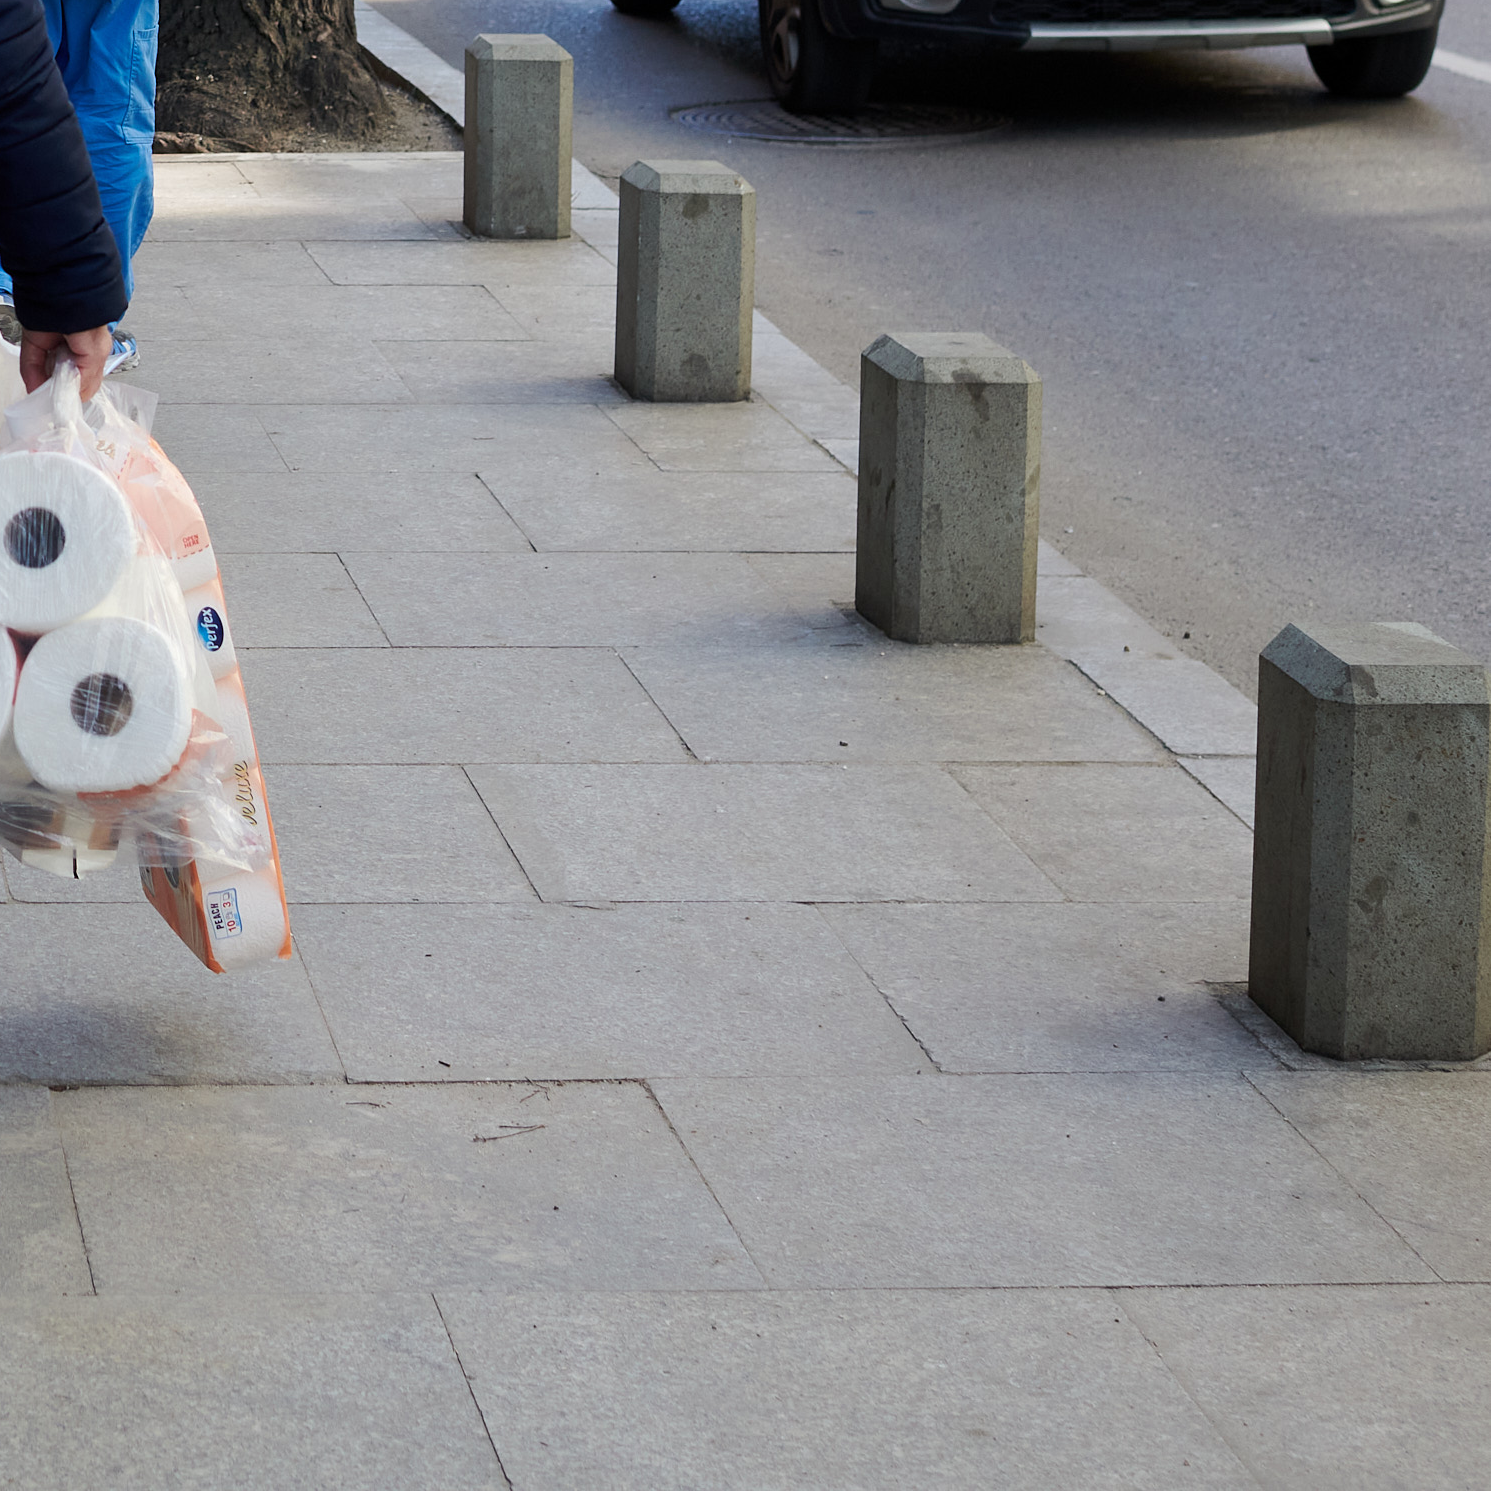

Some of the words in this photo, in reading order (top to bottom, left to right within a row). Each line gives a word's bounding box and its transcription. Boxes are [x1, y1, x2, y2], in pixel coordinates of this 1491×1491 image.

[182, 534, 199, 543] OPEN
[184, 540, 199, 549] HERE
[210, 903, 225, 930] PEACH
[226, 920, 236, 932] 10
